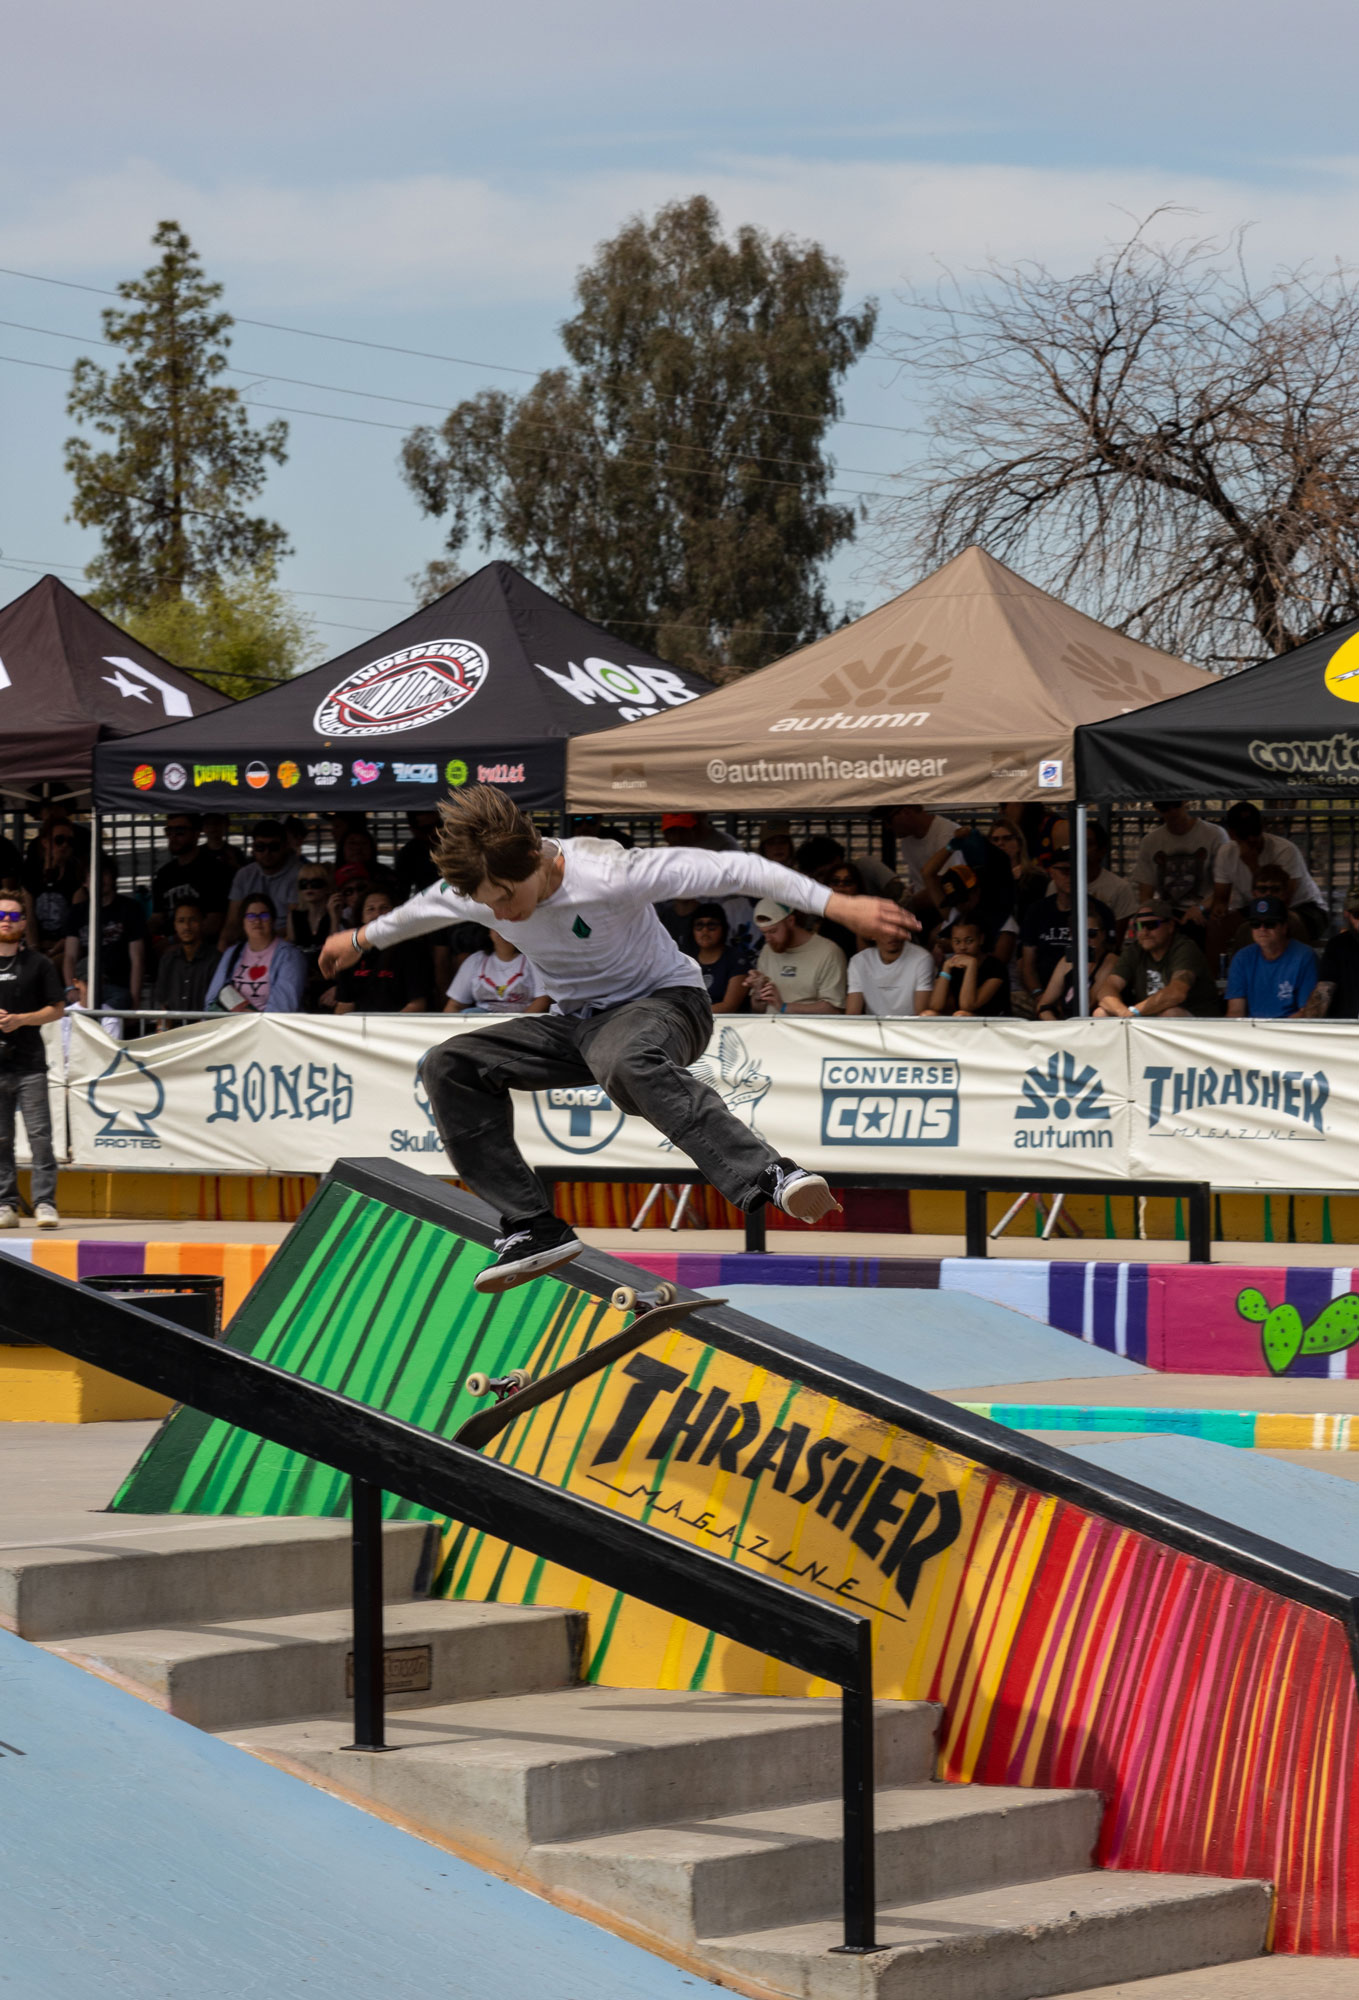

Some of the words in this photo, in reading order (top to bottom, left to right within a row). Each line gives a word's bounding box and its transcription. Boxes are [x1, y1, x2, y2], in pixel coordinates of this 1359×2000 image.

[350, 643, 481, 685] INDEPENDENT
[534, 657, 700, 706] MOB
[319, 704, 351, 735] TRUCK
[351, 702, 456, 735] COMPANY
[768, 711, 931, 732] autumn
[307, 761, 343, 777] MOB
[314, 776, 337, 786] GRIP
[706, 753, 948, 784] @autumnheadwear
[234, 964, 249, 979] I
[827, 1066, 955, 1086] CONVERSE
[205, 1061, 354, 1124] BONES
[1143, 1066, 1330, 1135] THRASHER
[826, 1096, 953, 1139] CONS
[94, 1138, 162, 1150] PRO-TEC
[1013, 1124, 1114, 1149] autumn
[1172, 1127, 1298, 1141] MAGAZINE
[591, 1352, 962, 1610] THRASHER
[624, 1483, 862, 1595] MAGAZINE
